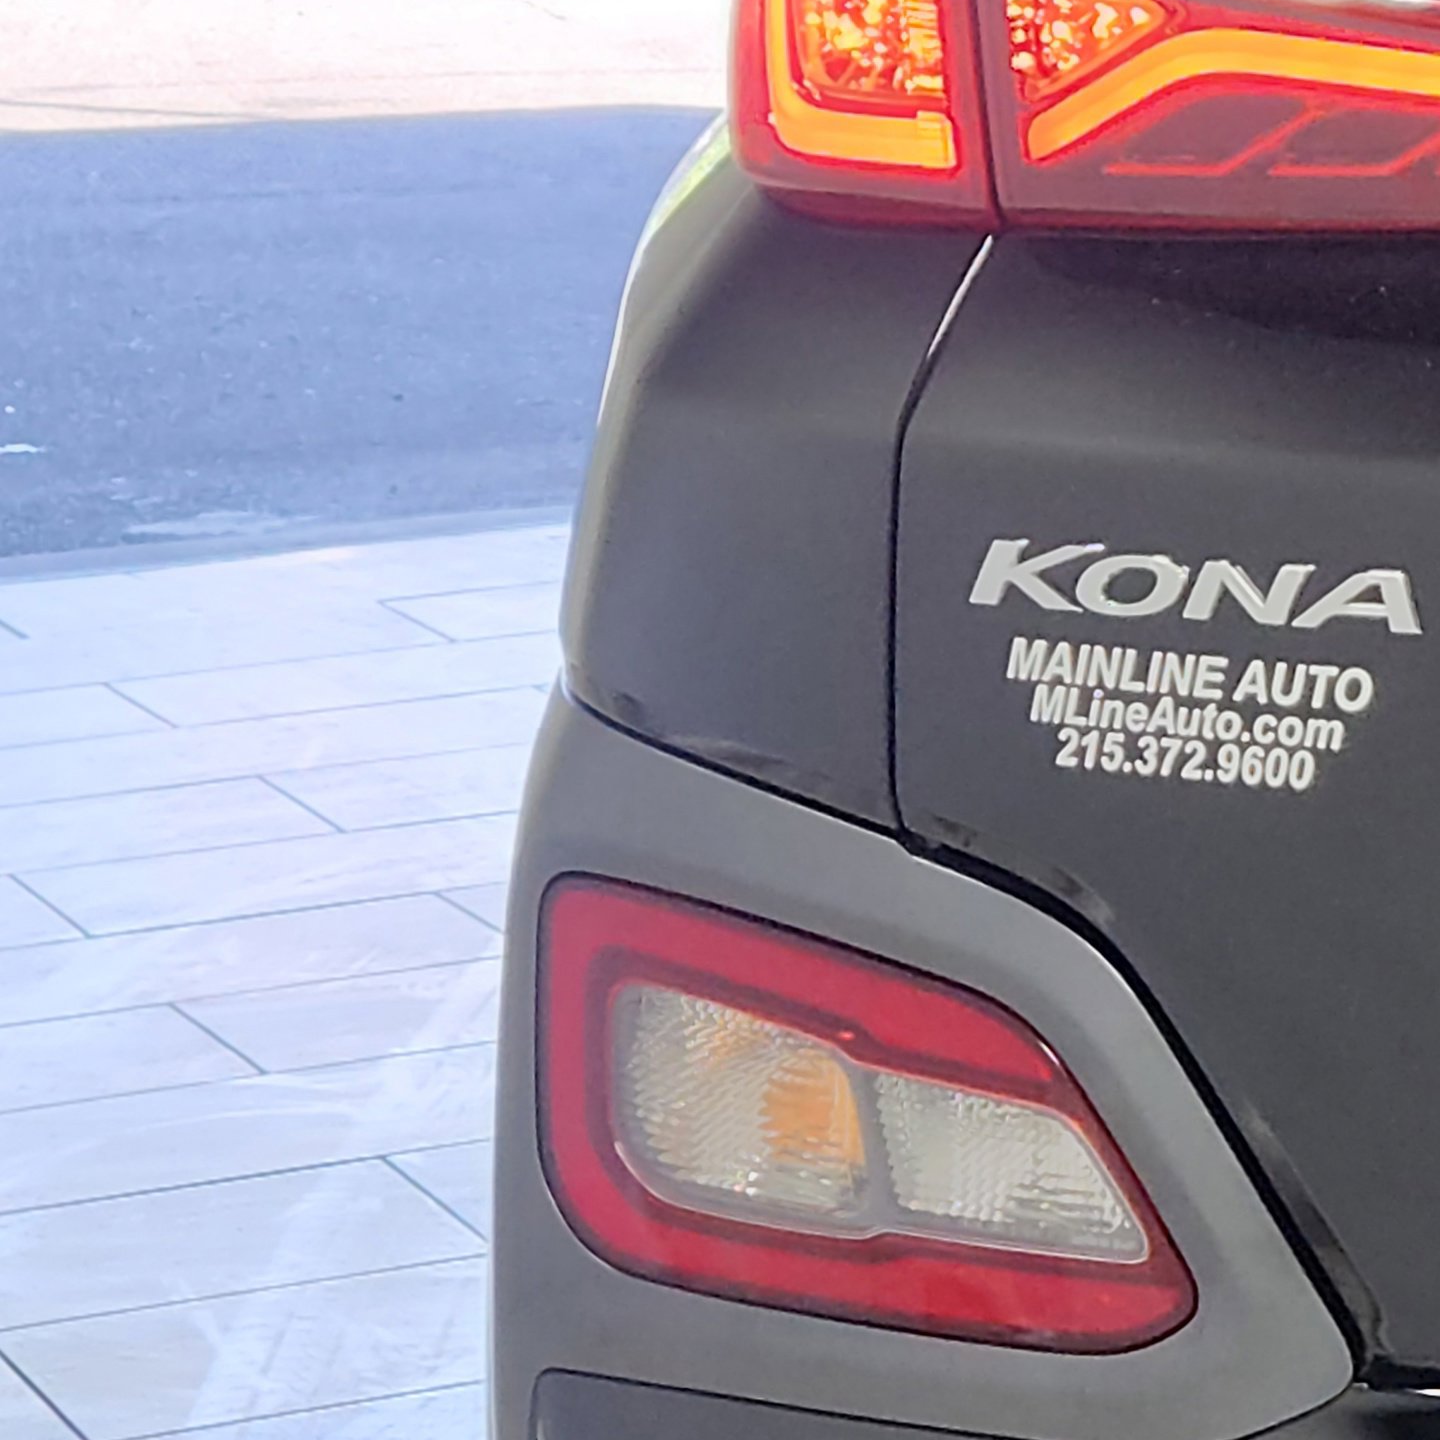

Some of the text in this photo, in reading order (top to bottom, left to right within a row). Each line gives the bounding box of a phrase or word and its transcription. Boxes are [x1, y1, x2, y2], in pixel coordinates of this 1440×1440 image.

[969, 538, 1423, 634] KONA
[1006, 637, 1374, 713] MAINLINE AUTO
[1030, 684, 1345, 753] MLineAuto.com
[1056, 728, 1316, 790] 215.372.9600
